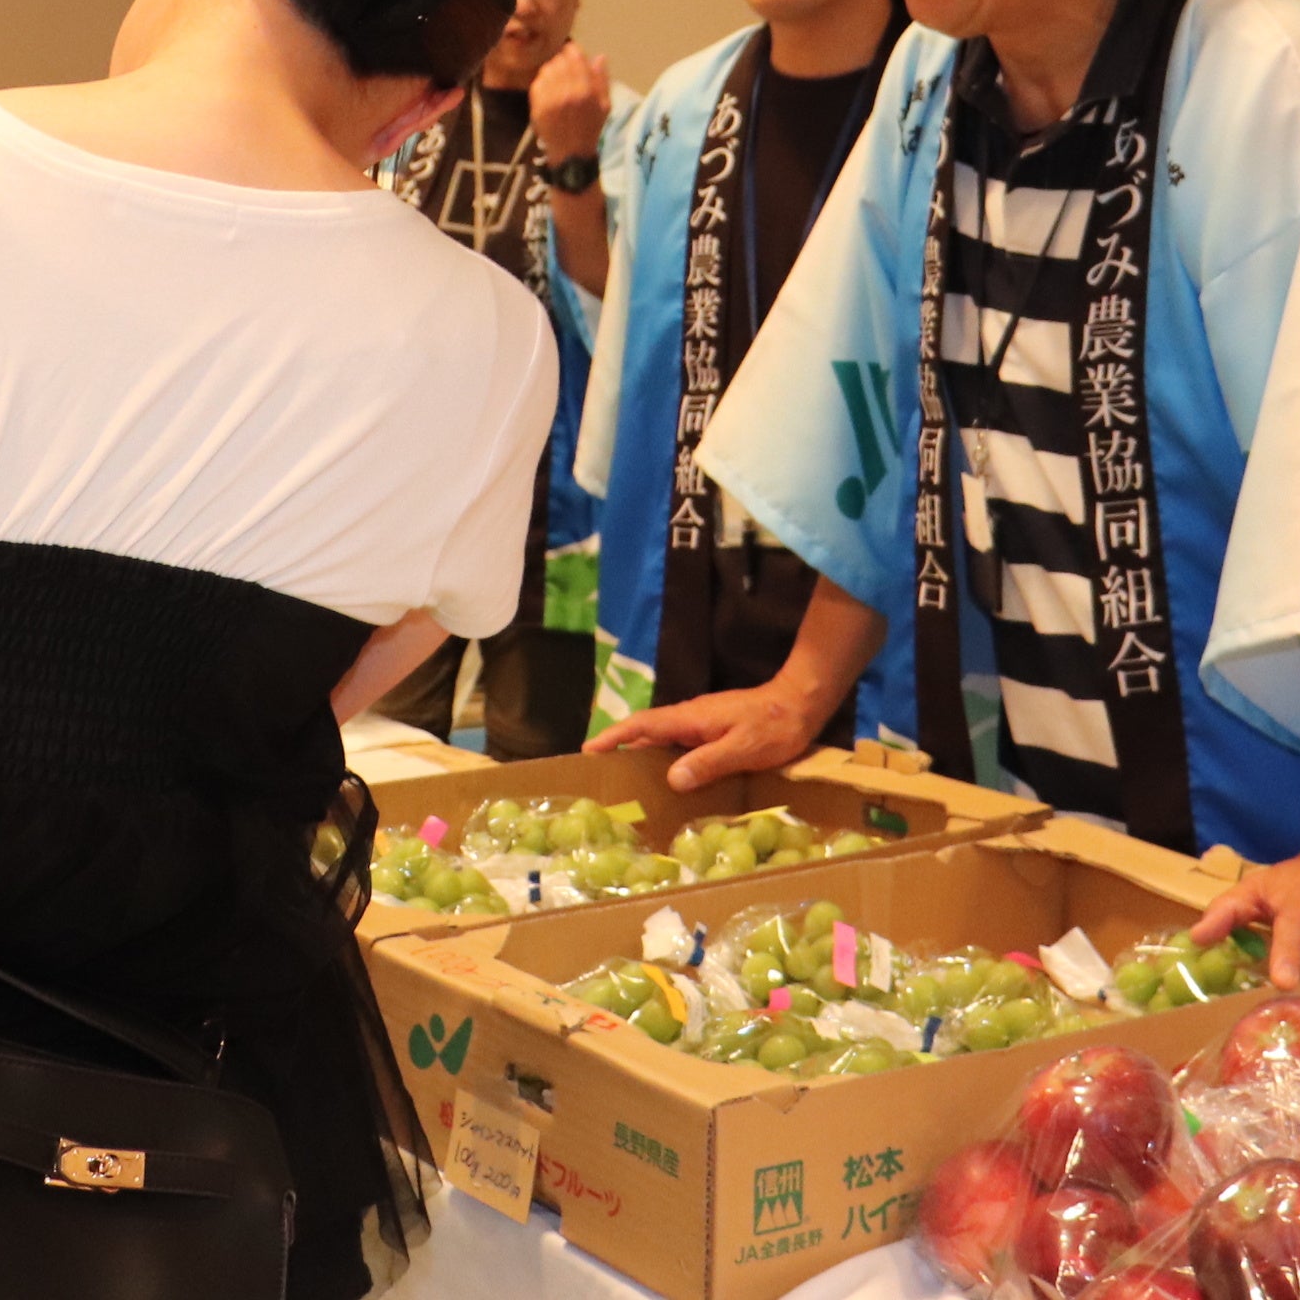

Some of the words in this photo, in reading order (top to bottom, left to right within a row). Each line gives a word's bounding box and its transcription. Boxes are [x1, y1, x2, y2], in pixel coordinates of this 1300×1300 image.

[670, 93, 744, 550] あづみ農業協同組合
[1079, 116, 1167, 699] あづみ農業協同組合
[612, 1121, 680, 1180] 長野県産
[842, 1146, 905, 1191] 松本
[734, 1228, 824, 1265] JA全農長野
